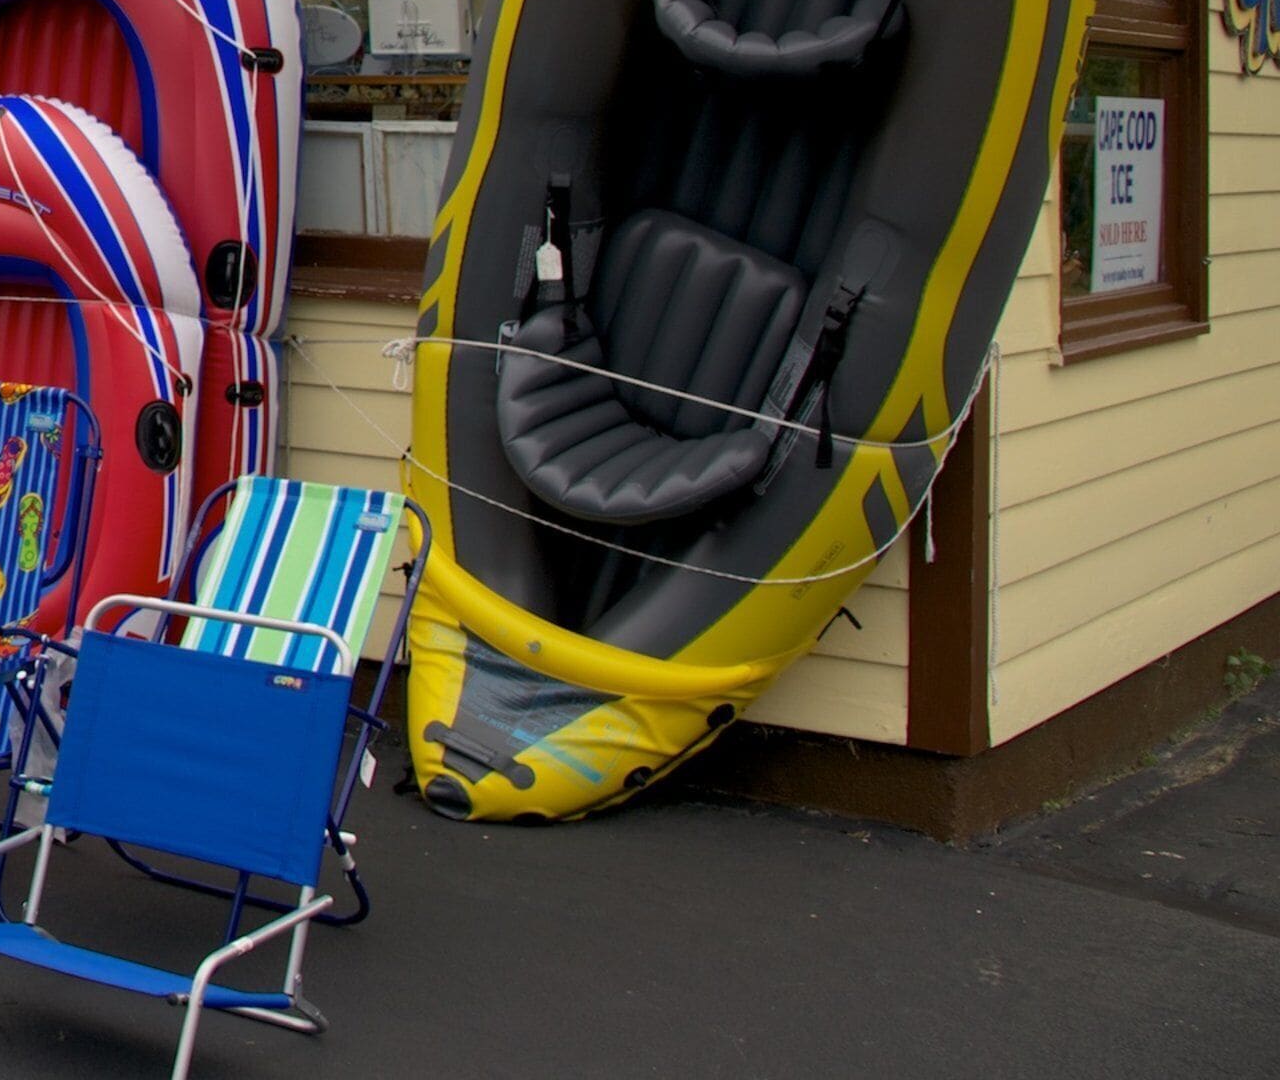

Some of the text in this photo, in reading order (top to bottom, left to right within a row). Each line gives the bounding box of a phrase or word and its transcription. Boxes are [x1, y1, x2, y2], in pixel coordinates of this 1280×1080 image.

[1098, 110, 1157, 151] CAPE COD
[1110, 164, 1134, 205] ICE
[1099, 219, 1148, 248] SOLD HERE
